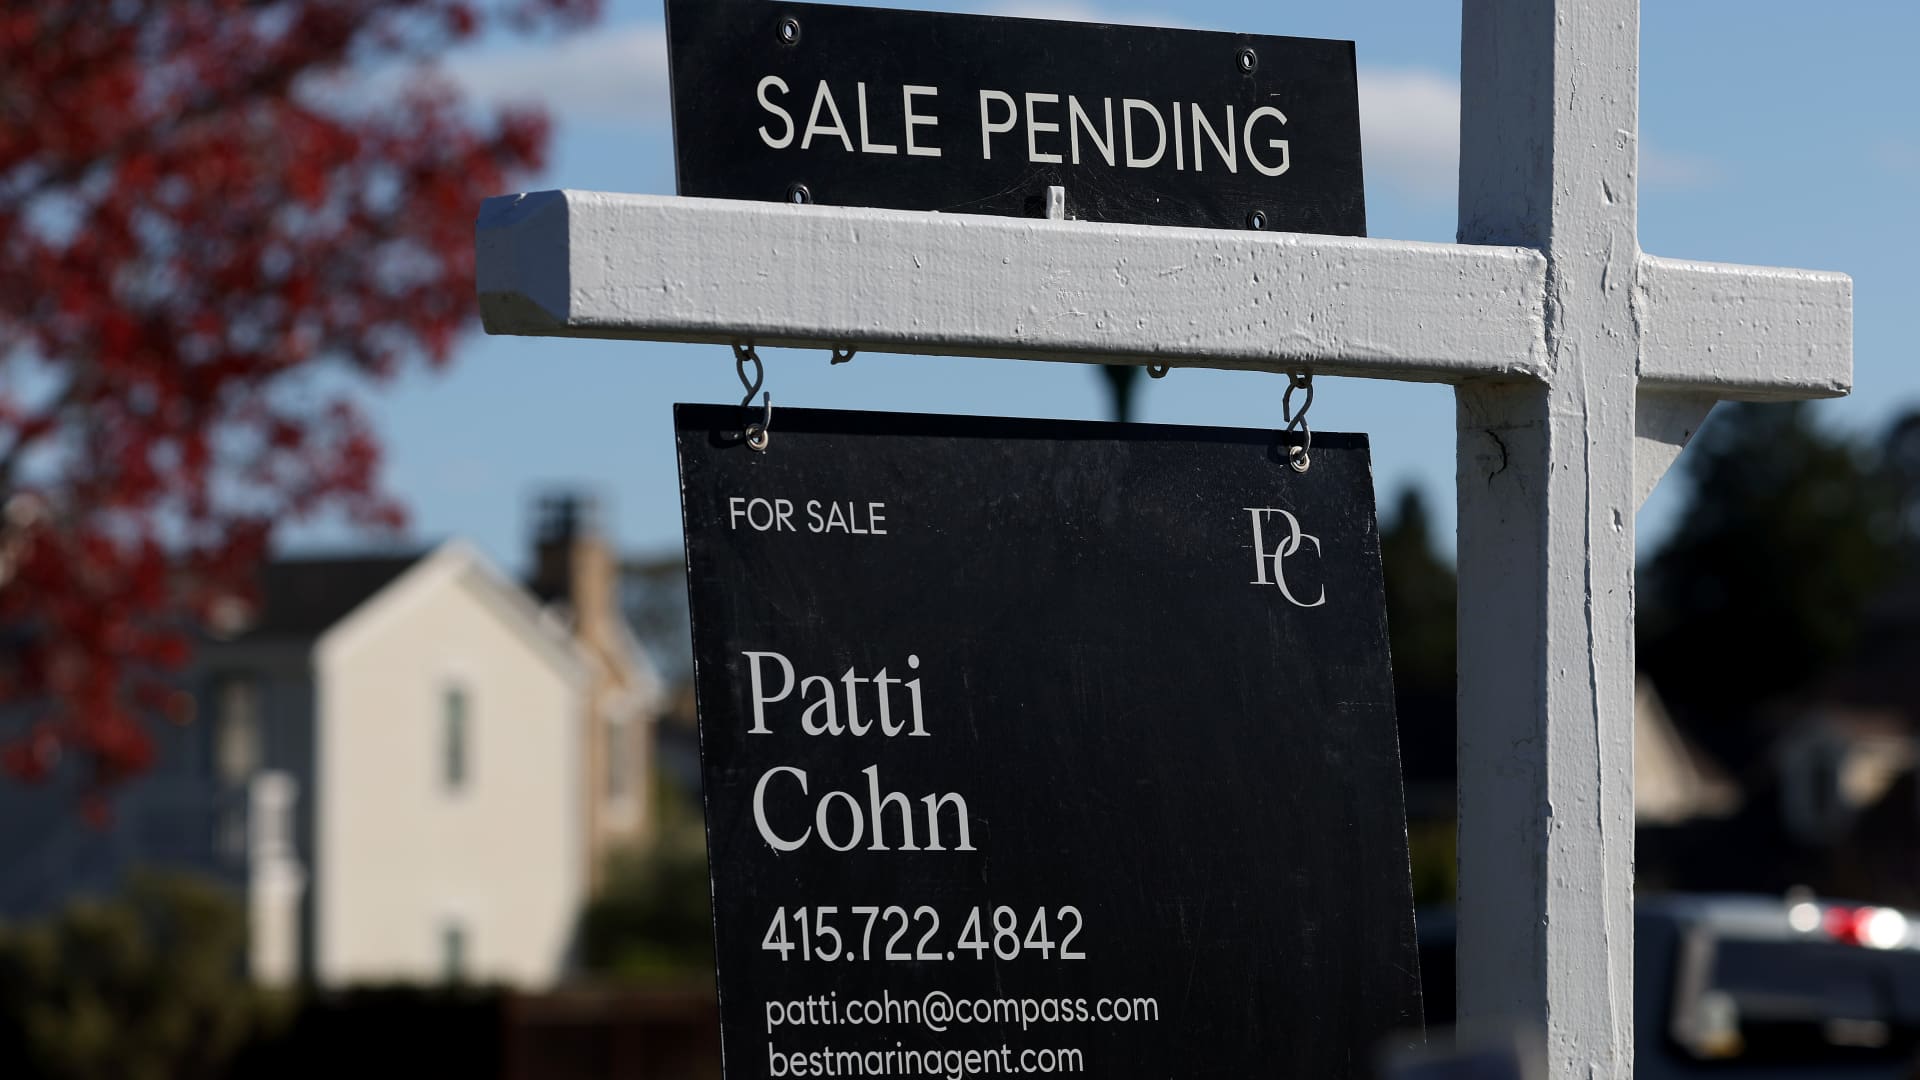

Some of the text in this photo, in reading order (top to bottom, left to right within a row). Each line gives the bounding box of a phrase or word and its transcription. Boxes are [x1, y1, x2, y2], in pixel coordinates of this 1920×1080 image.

[756, 75, 1291, 177] SALE PENDING
[729, 497, 888, 535] FOR SALE
[741, 651, 931, 737] Patti
[753, 764, 977, 853] Cohn
[761, 905, 1086, 962] 415.722.4842
[766, 989, 1159, 1034] patti.cohn@compass.com
[768, 1041, 1084, 1080] bestmarinagent.com
